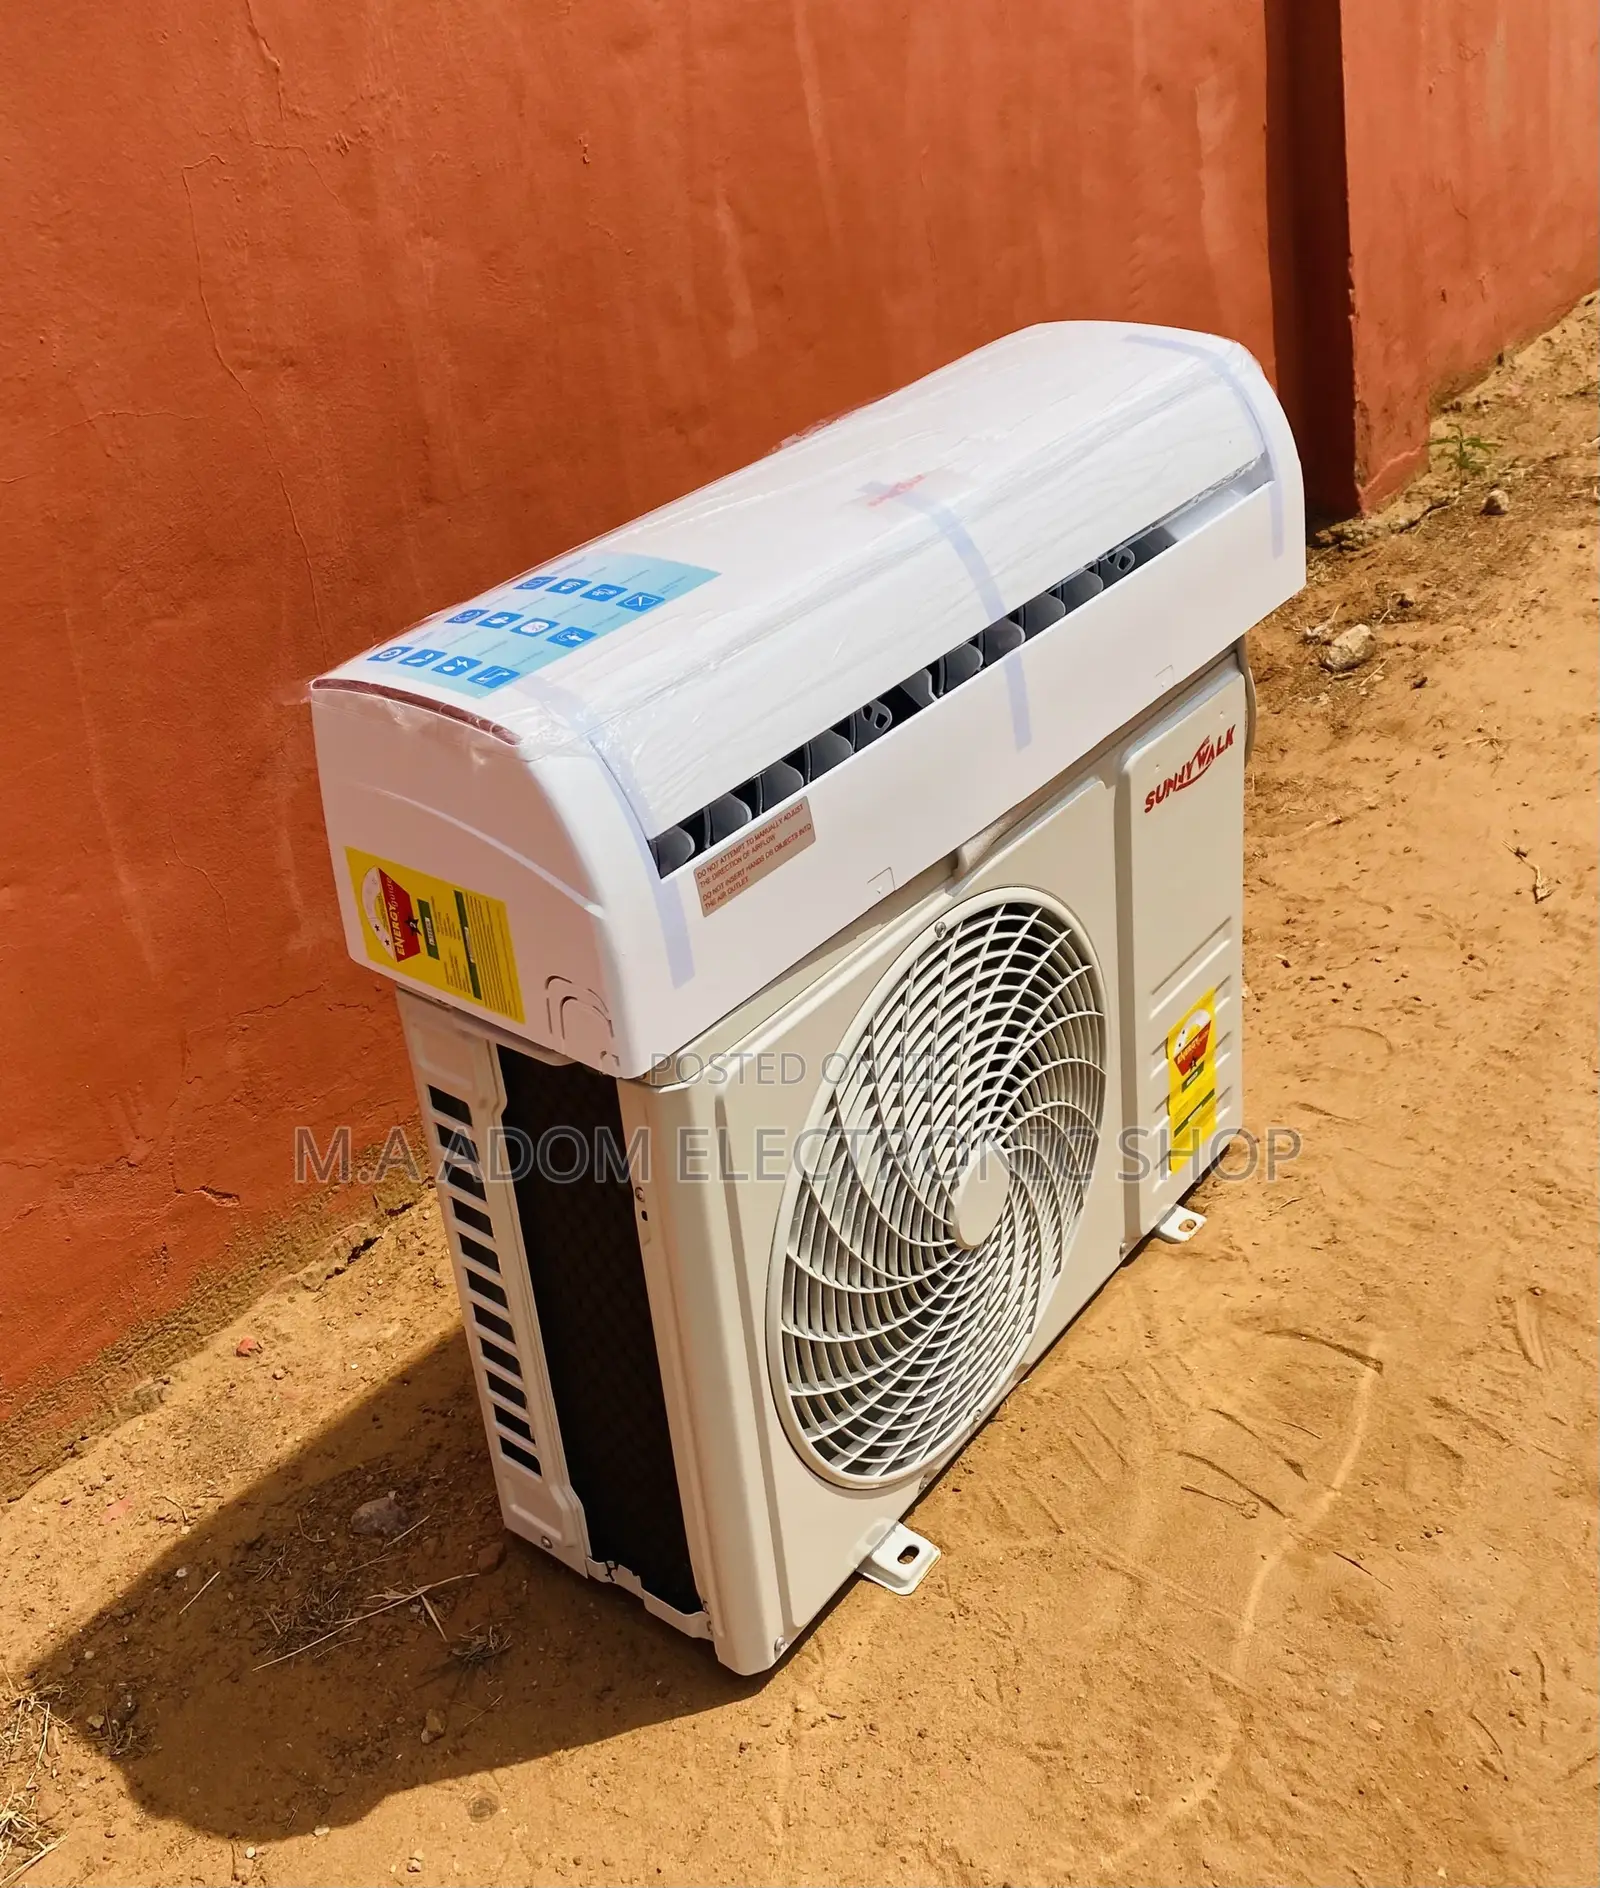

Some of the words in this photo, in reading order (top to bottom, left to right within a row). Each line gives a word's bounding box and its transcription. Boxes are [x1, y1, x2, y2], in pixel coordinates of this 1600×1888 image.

[697, 868, 706, 879] DO
[707, 861, 719, 872] NOT
[720, 842, 745, 864] ATTEMPT
[746, 836, 755, 846] TO
[754, 818, 783, 841] MANUALLY
[784, 804, 804, 820] ADJUST
[700, 876, 711, 888] THE
[712, 857, 742, 880] DIRECTION
[743, 849, 751, 859] OF
[751, 835, 776, 853] AIRFLOW
[703, 891, 712, 902] DO
[713, 883, 724, 895] NOT
[725, 869, 745, 886] INSERT
[746, 856, 765, 872] HANDS
[774, 833, 798, 853] OBJECTS
[799, 823, 811, 836] INTO
[705, 898, 717, 910] THE
[717, 891, 727, 903] AIR
[728, 876, 749, 895] OUTLET
